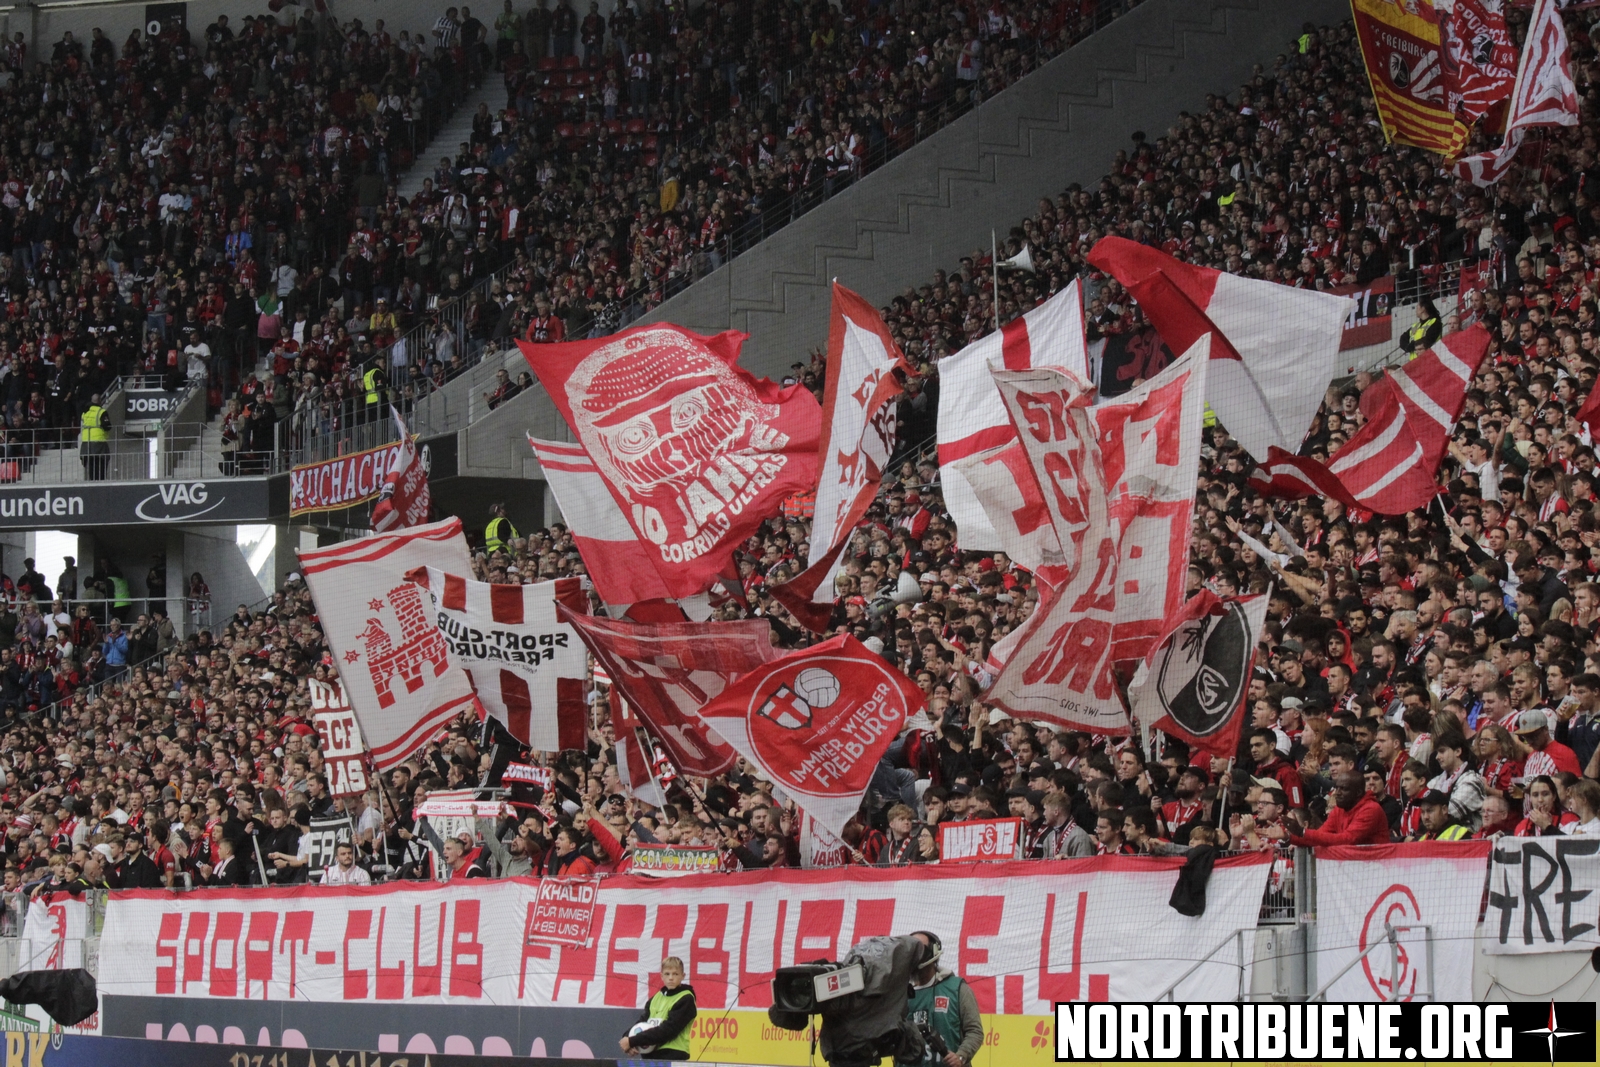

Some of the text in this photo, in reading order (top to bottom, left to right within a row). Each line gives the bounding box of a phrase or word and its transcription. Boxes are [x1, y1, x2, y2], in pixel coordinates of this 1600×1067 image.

[159, 483, 208, 505] VAG
[659, 453, 788, 563] CORRILLO ULTRAS
[789, 682, 890, 783] IMMER WIEDER
[813, 701, 901, 788] FREIBURG
[541, 885, 593, 903] KHALID
[537, 903, 590, 922] FÜR IMMER
[540, 921, 579, 936] BEI UNS
[155, 899, 483, 1001] SPORT-CLUB
[699, 1017, 739, 1040] LOTTO
